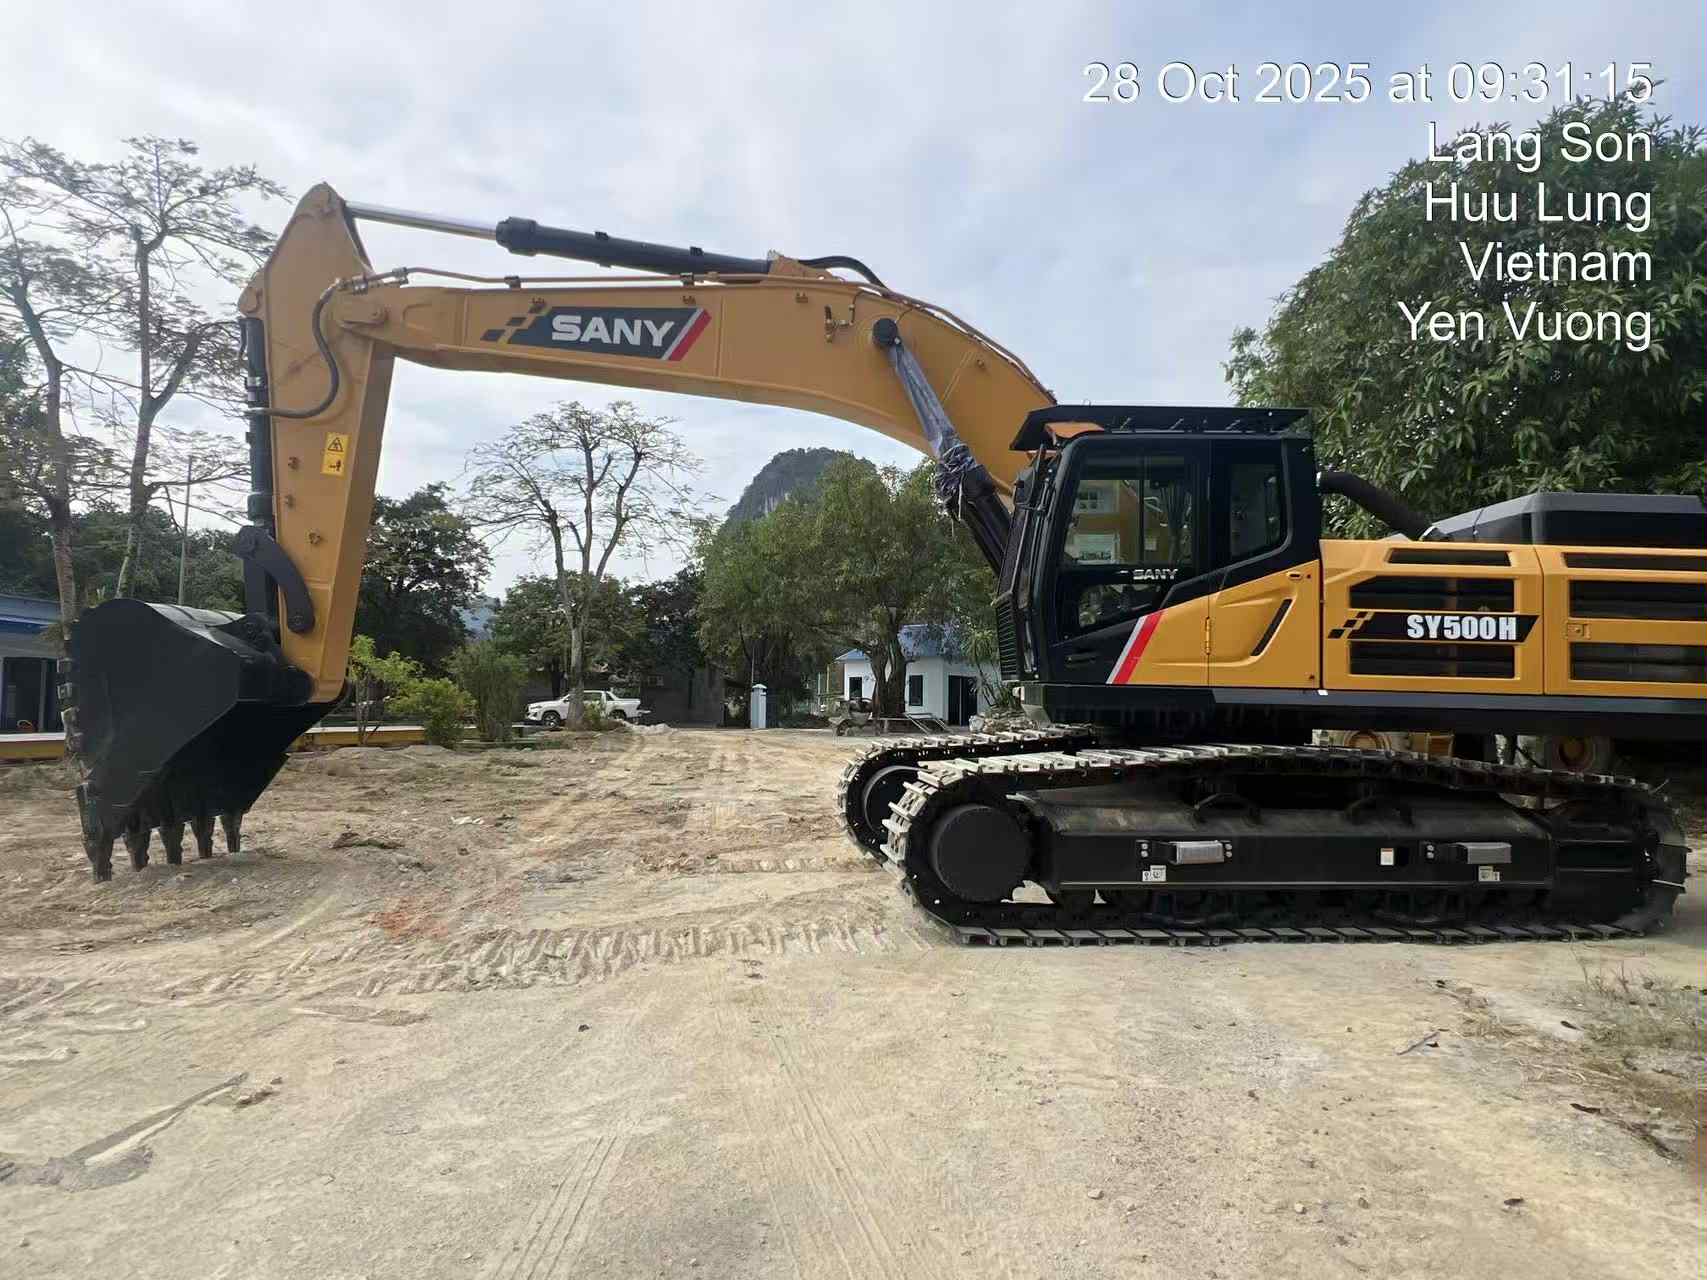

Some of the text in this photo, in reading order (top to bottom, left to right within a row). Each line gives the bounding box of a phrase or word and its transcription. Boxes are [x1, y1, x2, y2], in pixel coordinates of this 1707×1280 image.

[551, 314, 675, 347] SANY
[1132, 568, 1178, 580] SANY
[1407, 614, 1517, 640] SY500H
